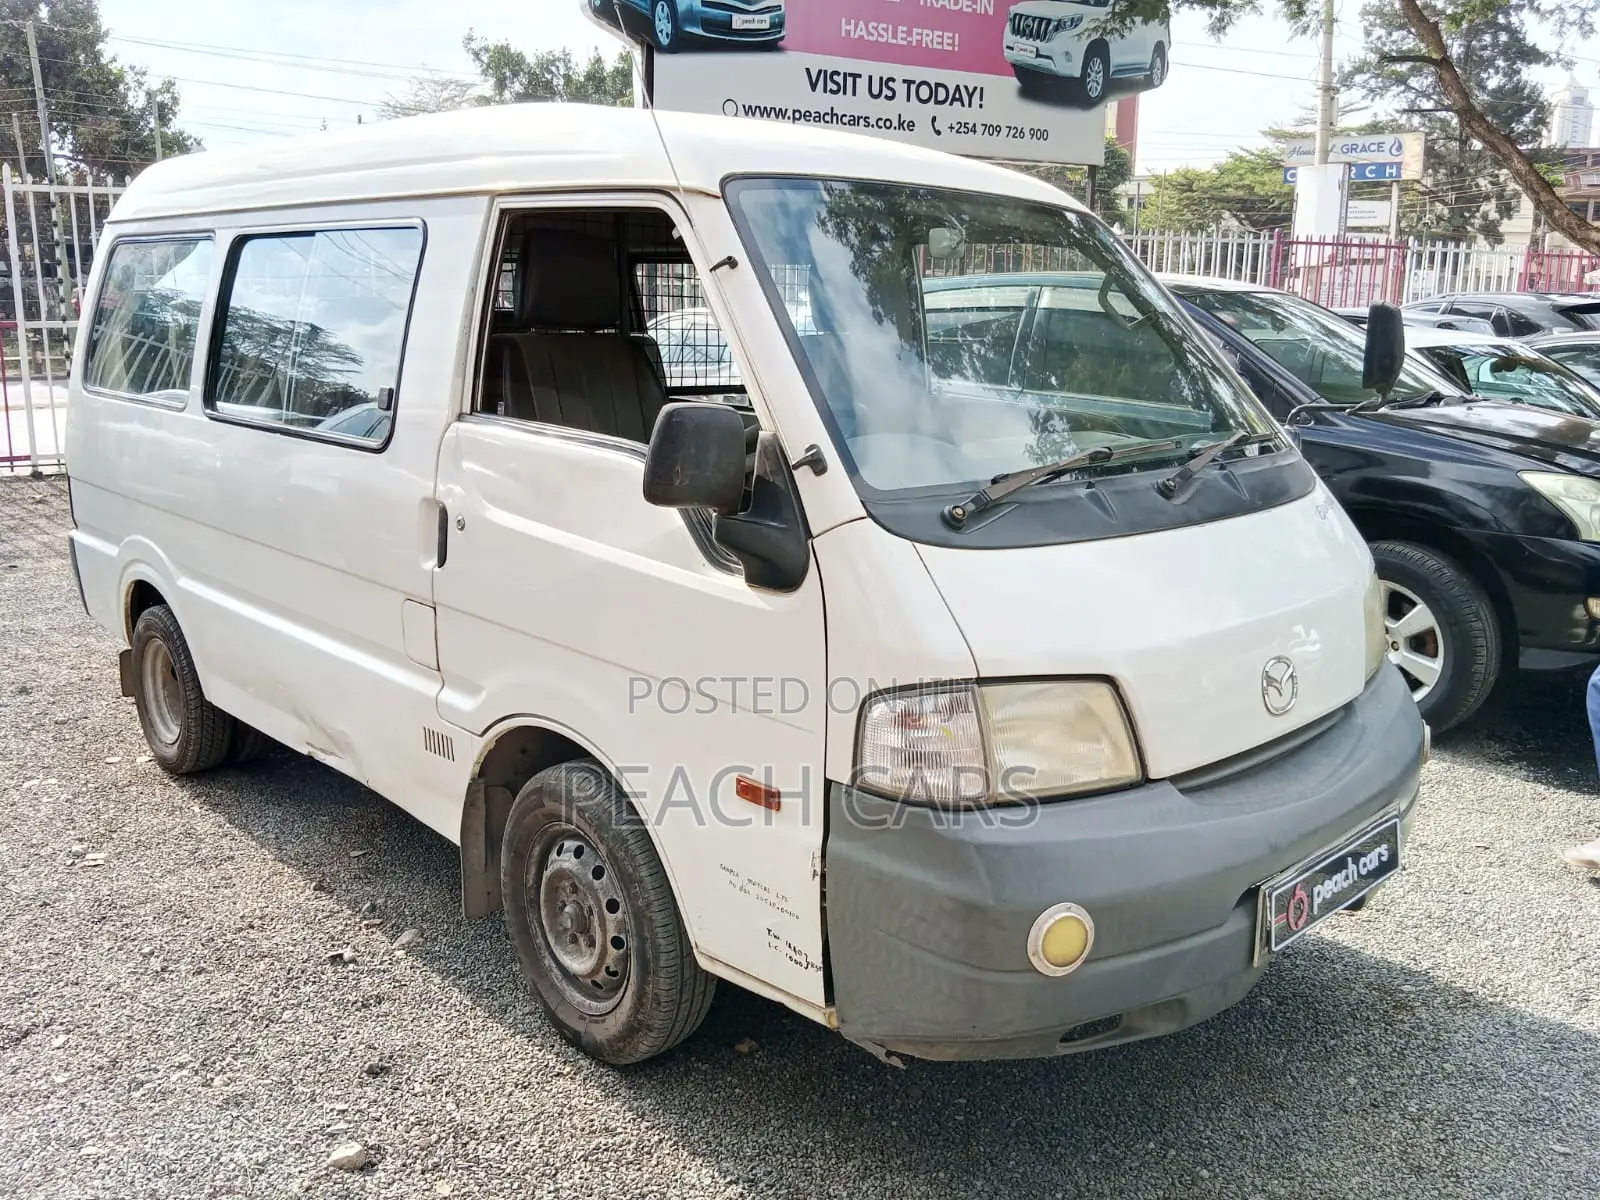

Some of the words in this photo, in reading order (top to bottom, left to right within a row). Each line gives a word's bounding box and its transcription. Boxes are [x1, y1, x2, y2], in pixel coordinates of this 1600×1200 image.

[841, 17, 959, 51] HASSLE-FREE!
[804, 67, 862, 97] VISIT
[867, 74, 897, 101] US
[902, 78, 985, 110] TODAY!
[742, 103, 916, 132] www.peachcars.co.ke
[947, 121, 978, 136] +254
[980, 123, 1002, 137] 709
[1005, 125, 1026, 140] 726
[1028, 127, 1049, 141] 900
[1340, 141, 1386, 154] GRACE
[1312, 856, 1358, 915] peach
[1359, 843, 1389, 875] cars
